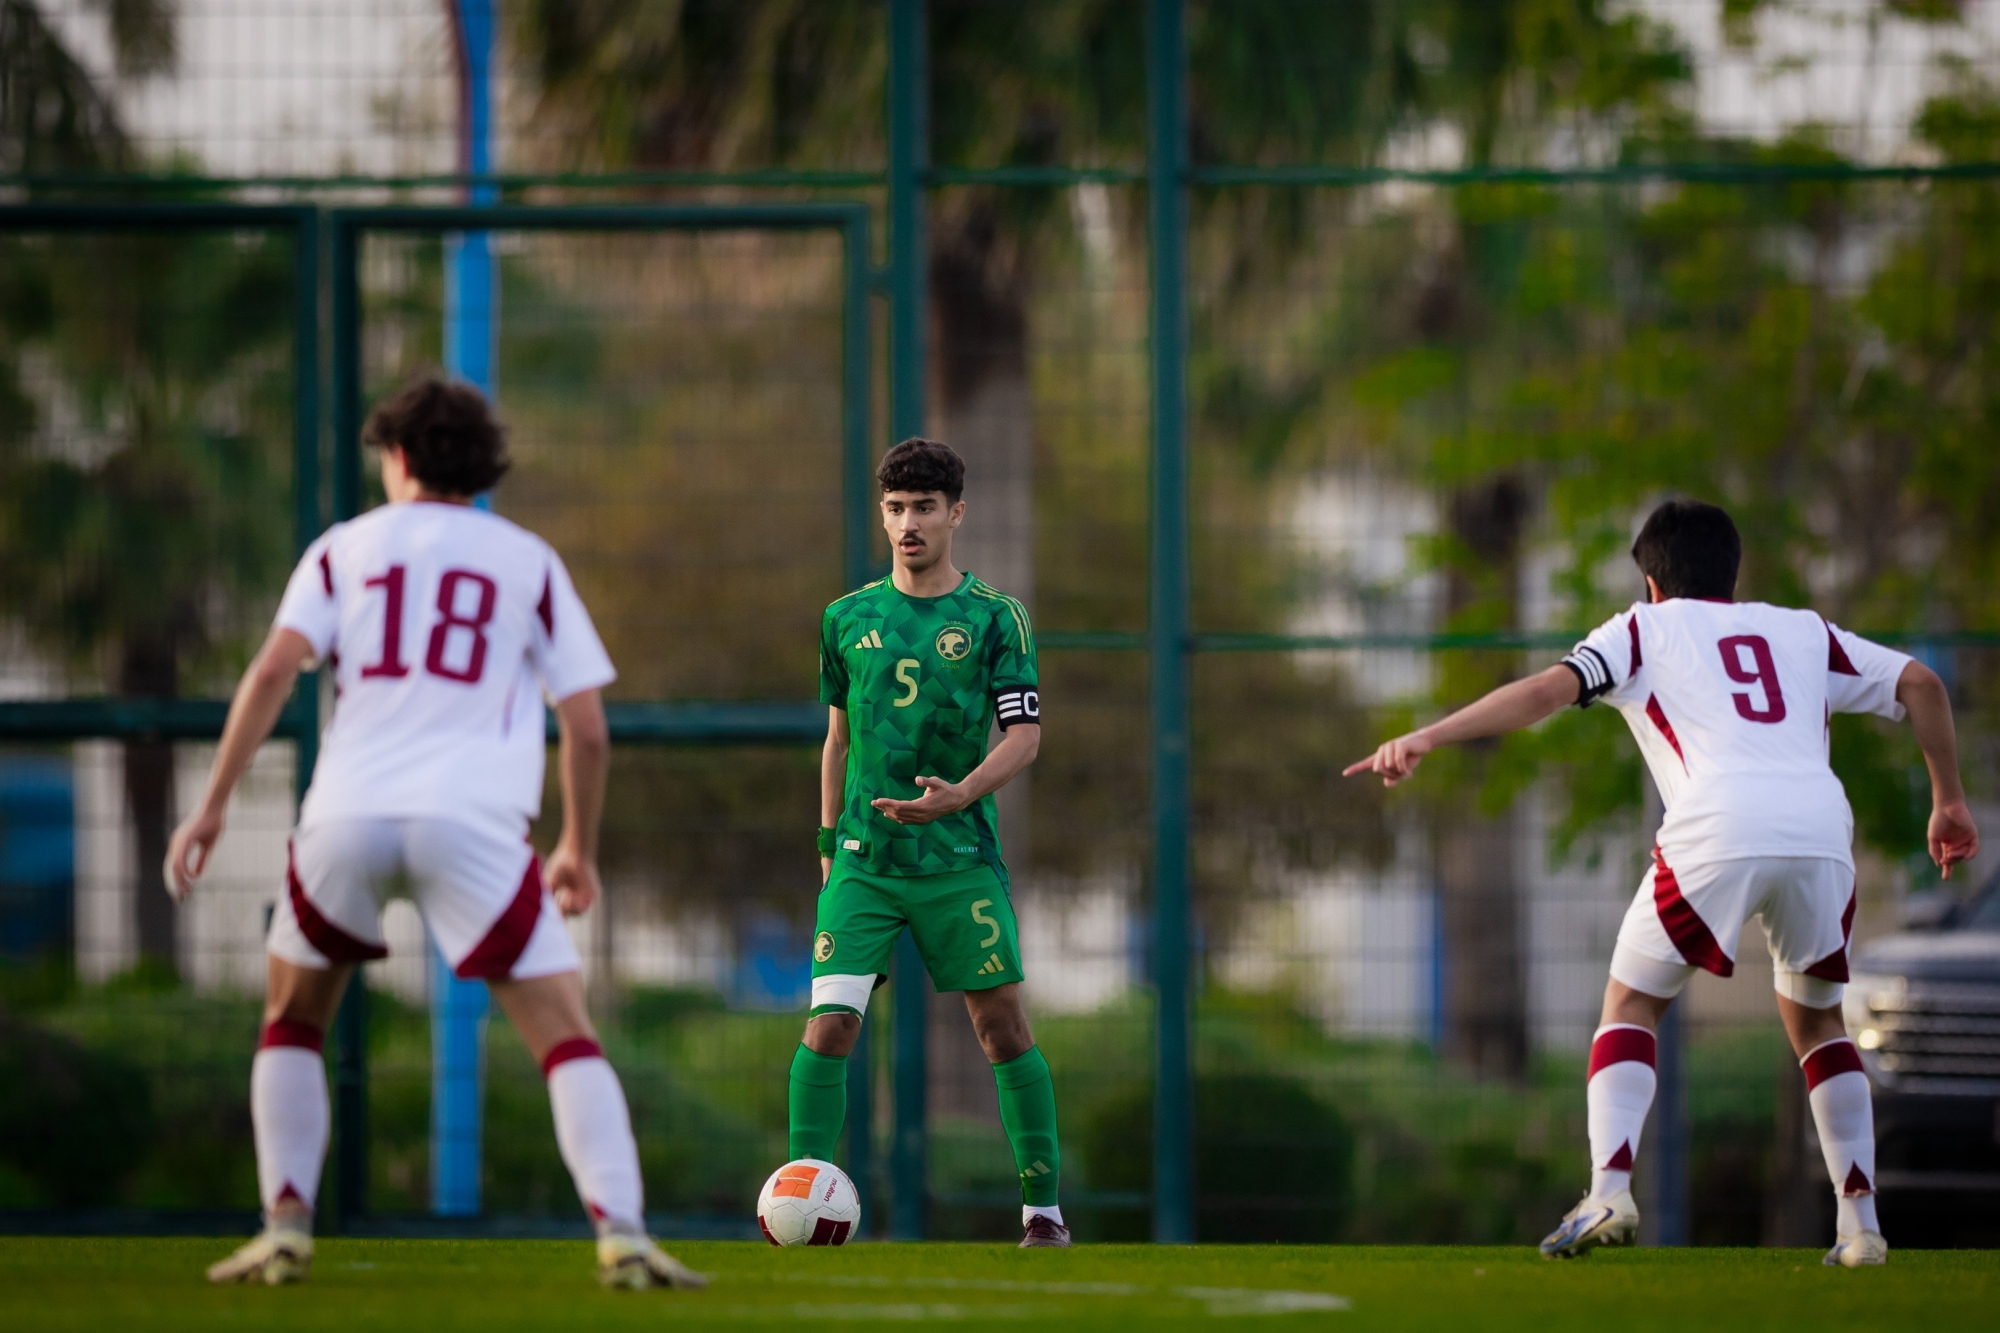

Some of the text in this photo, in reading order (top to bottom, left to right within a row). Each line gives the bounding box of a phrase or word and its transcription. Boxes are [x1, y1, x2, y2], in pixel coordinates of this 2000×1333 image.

[361, 565, 496, 686] 18
[893, 658, 920, 707] 5
[1717, 634, 1786, 723] 9
[1023, 691, 1039, 717] C
[970, 898, 1000, 949] 5
[823, 1177, 838, 1203] molten
